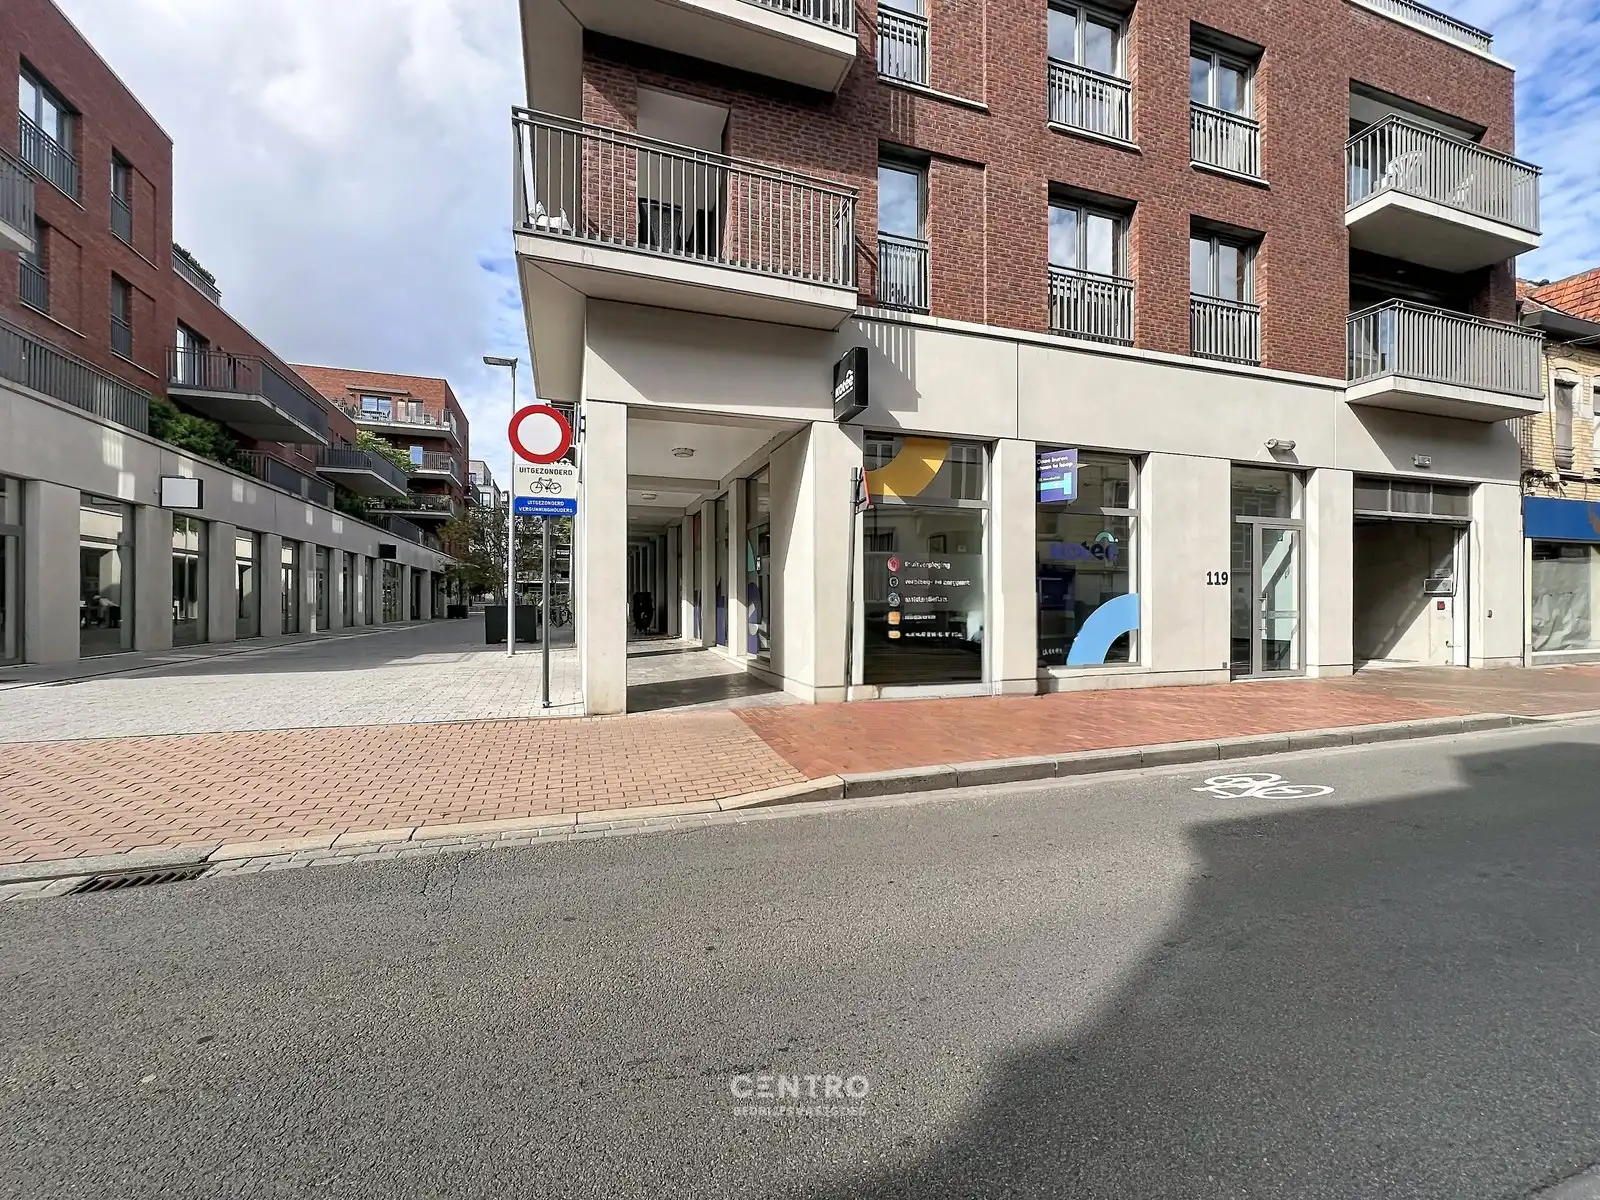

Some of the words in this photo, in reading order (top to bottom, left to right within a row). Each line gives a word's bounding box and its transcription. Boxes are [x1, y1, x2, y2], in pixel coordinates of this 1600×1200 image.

[519, 466, 573, 475] UITGEZONDERD
[518, 506, 573, 514] VERGUNNINGHOUDERS
[1206, 571, 1229, 586] 119
